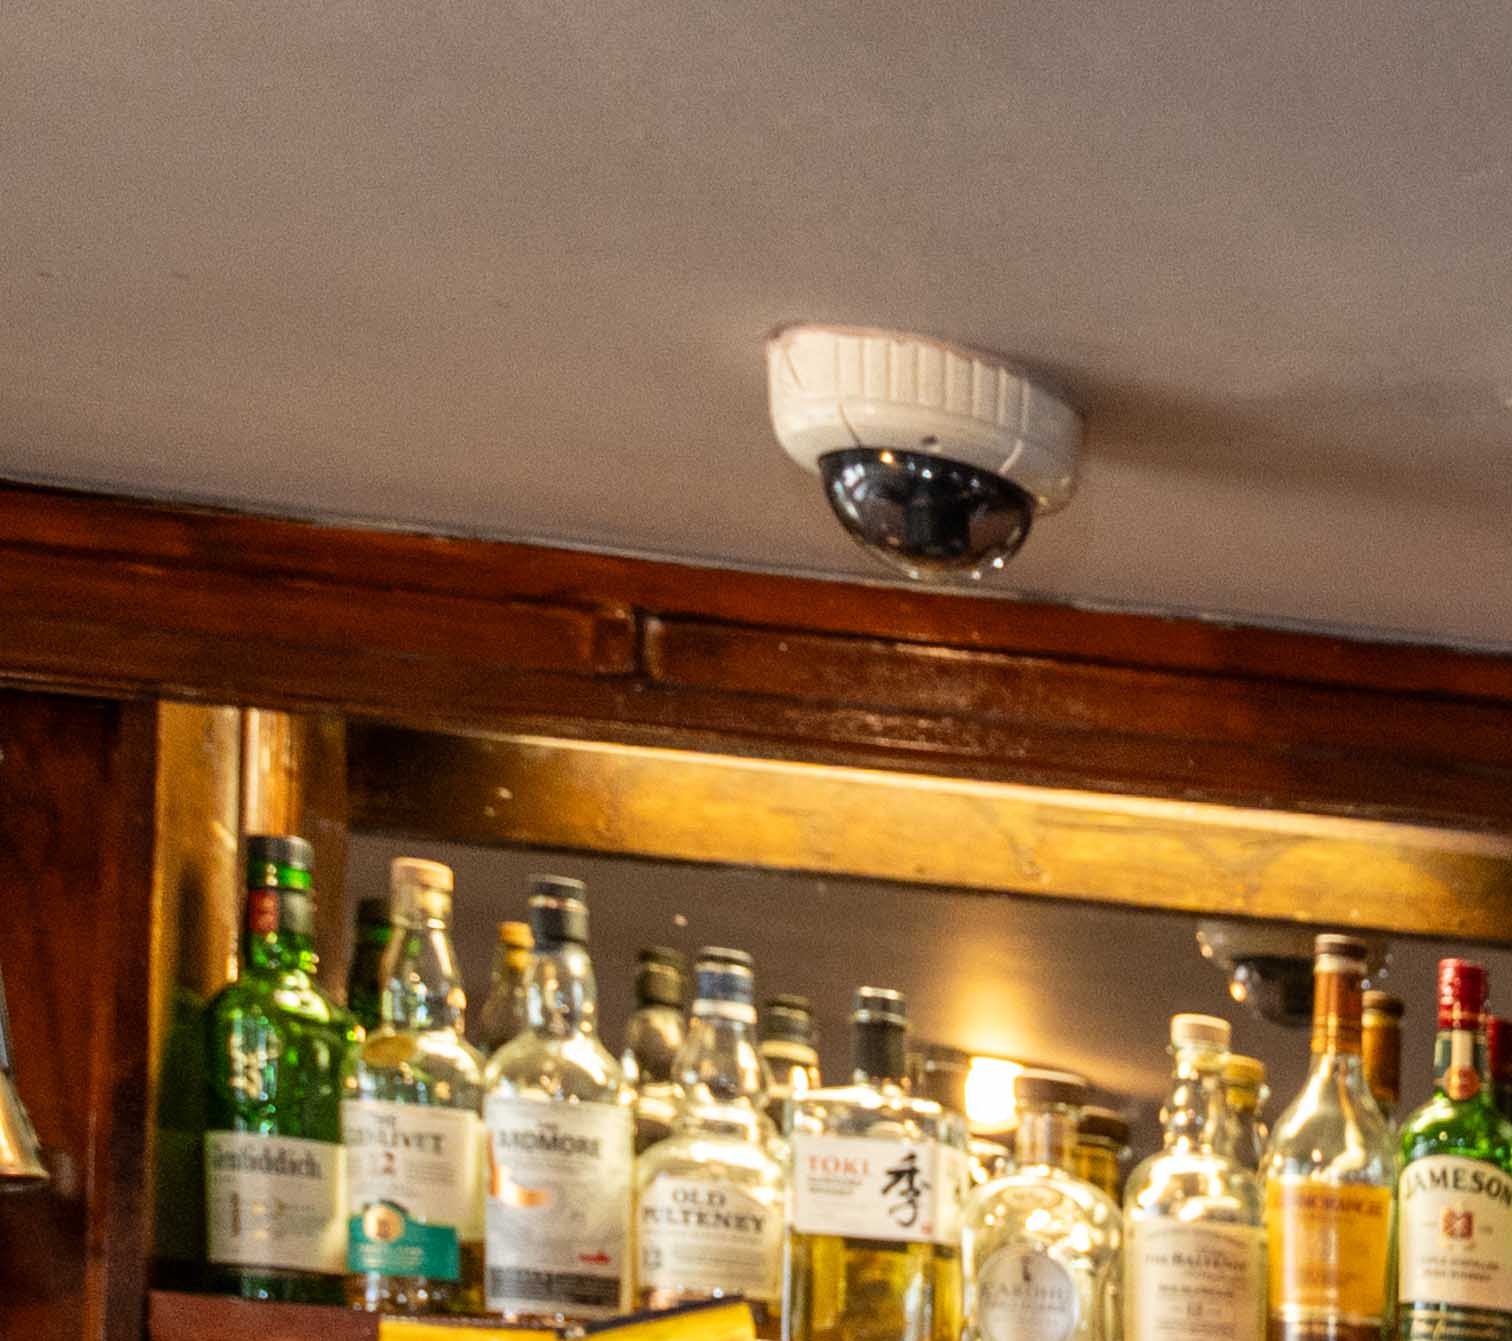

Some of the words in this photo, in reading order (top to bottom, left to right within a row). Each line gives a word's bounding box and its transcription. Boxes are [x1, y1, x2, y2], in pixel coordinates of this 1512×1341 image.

[808, 1155, 870, 1175] TOKI
[1404, 1166, 1512, 1206] JAMESON
[671, 1188, 727, 1207] OLD
